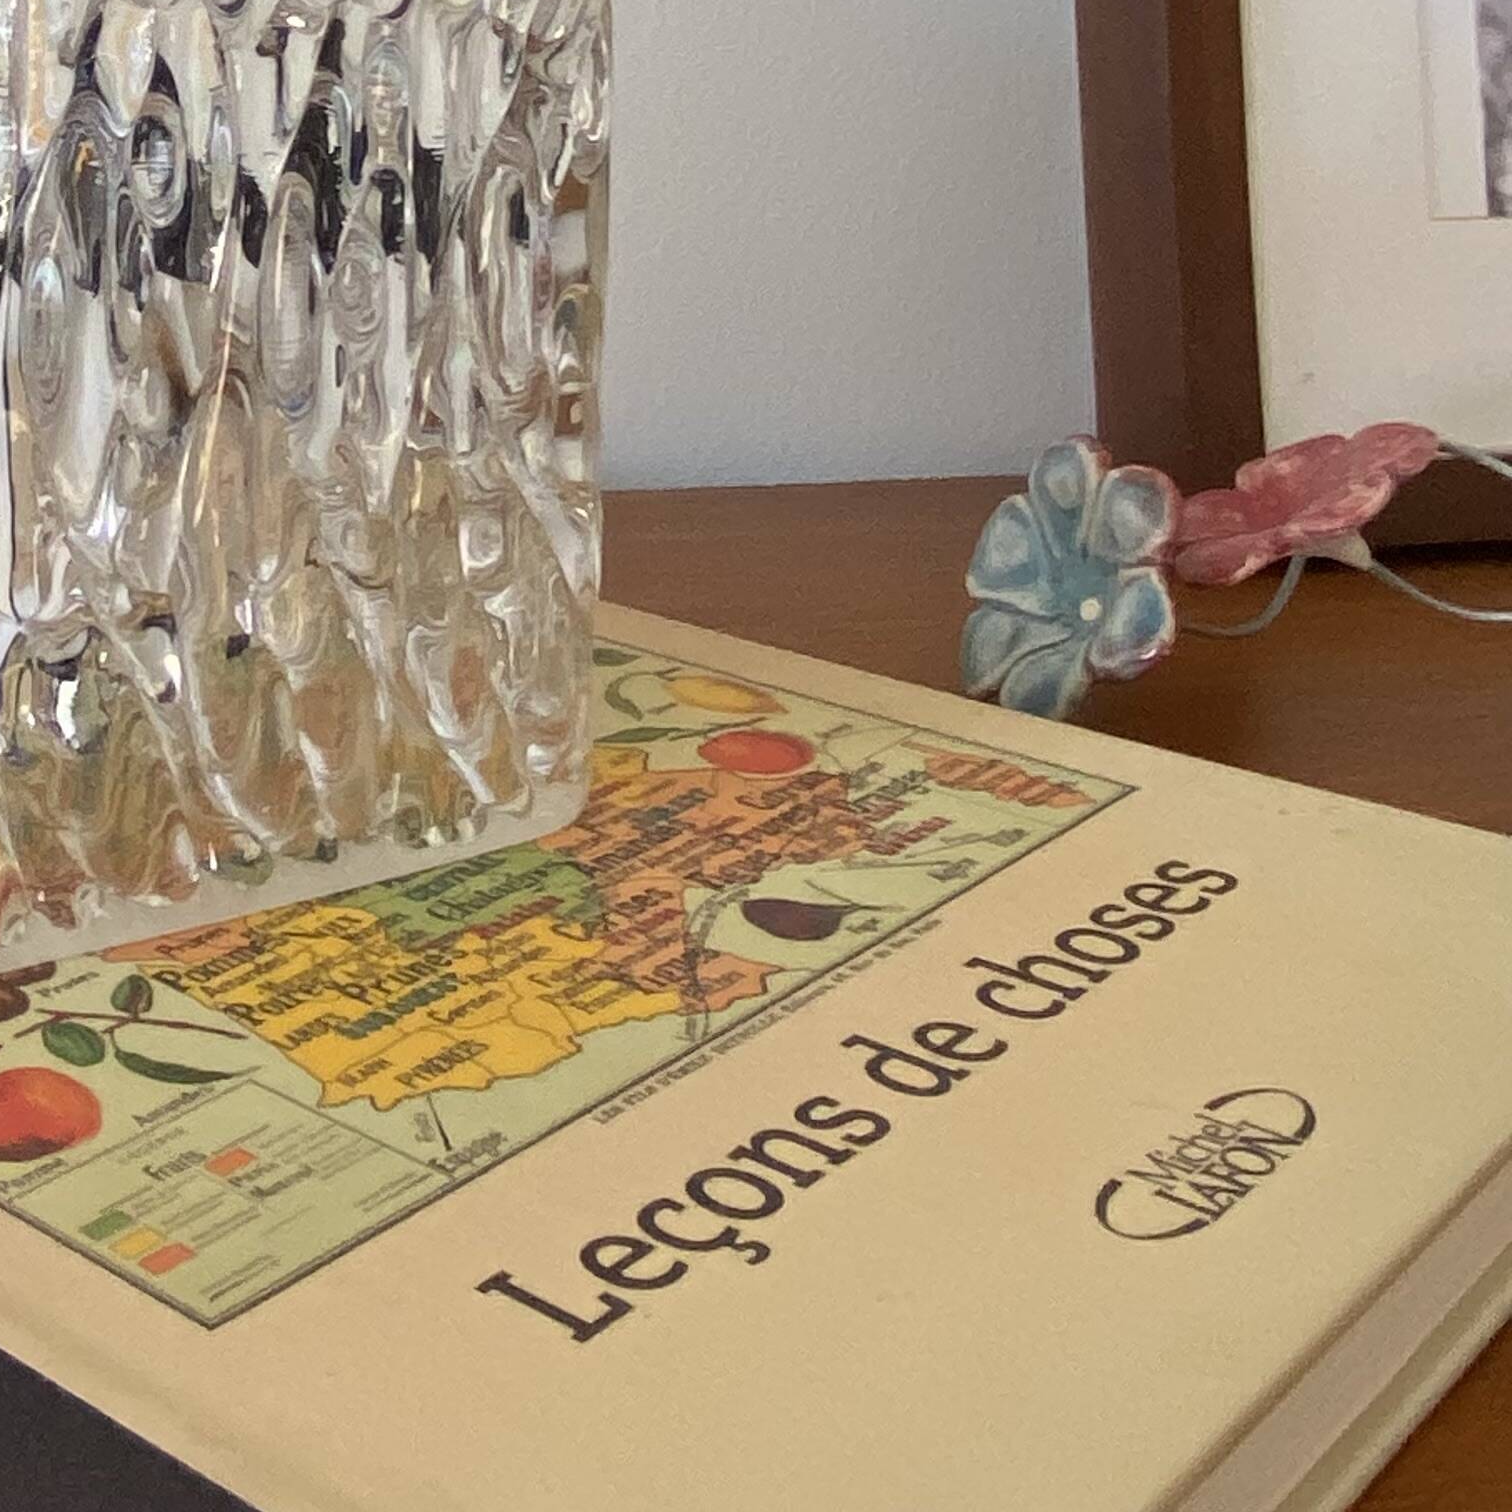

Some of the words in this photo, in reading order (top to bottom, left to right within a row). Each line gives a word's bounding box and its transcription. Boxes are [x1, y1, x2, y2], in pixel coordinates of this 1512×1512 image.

[334, 946, 469, 1005] Prunes
[476, 1093, 891, 1343] Leçons
[840, 1019, 1009, 1097] de
[964, 859, 1239, 1021] choses
[1125, 1113, 1243, 1190] Michel
[1152, 1120, 1304, 1222] LAFON
